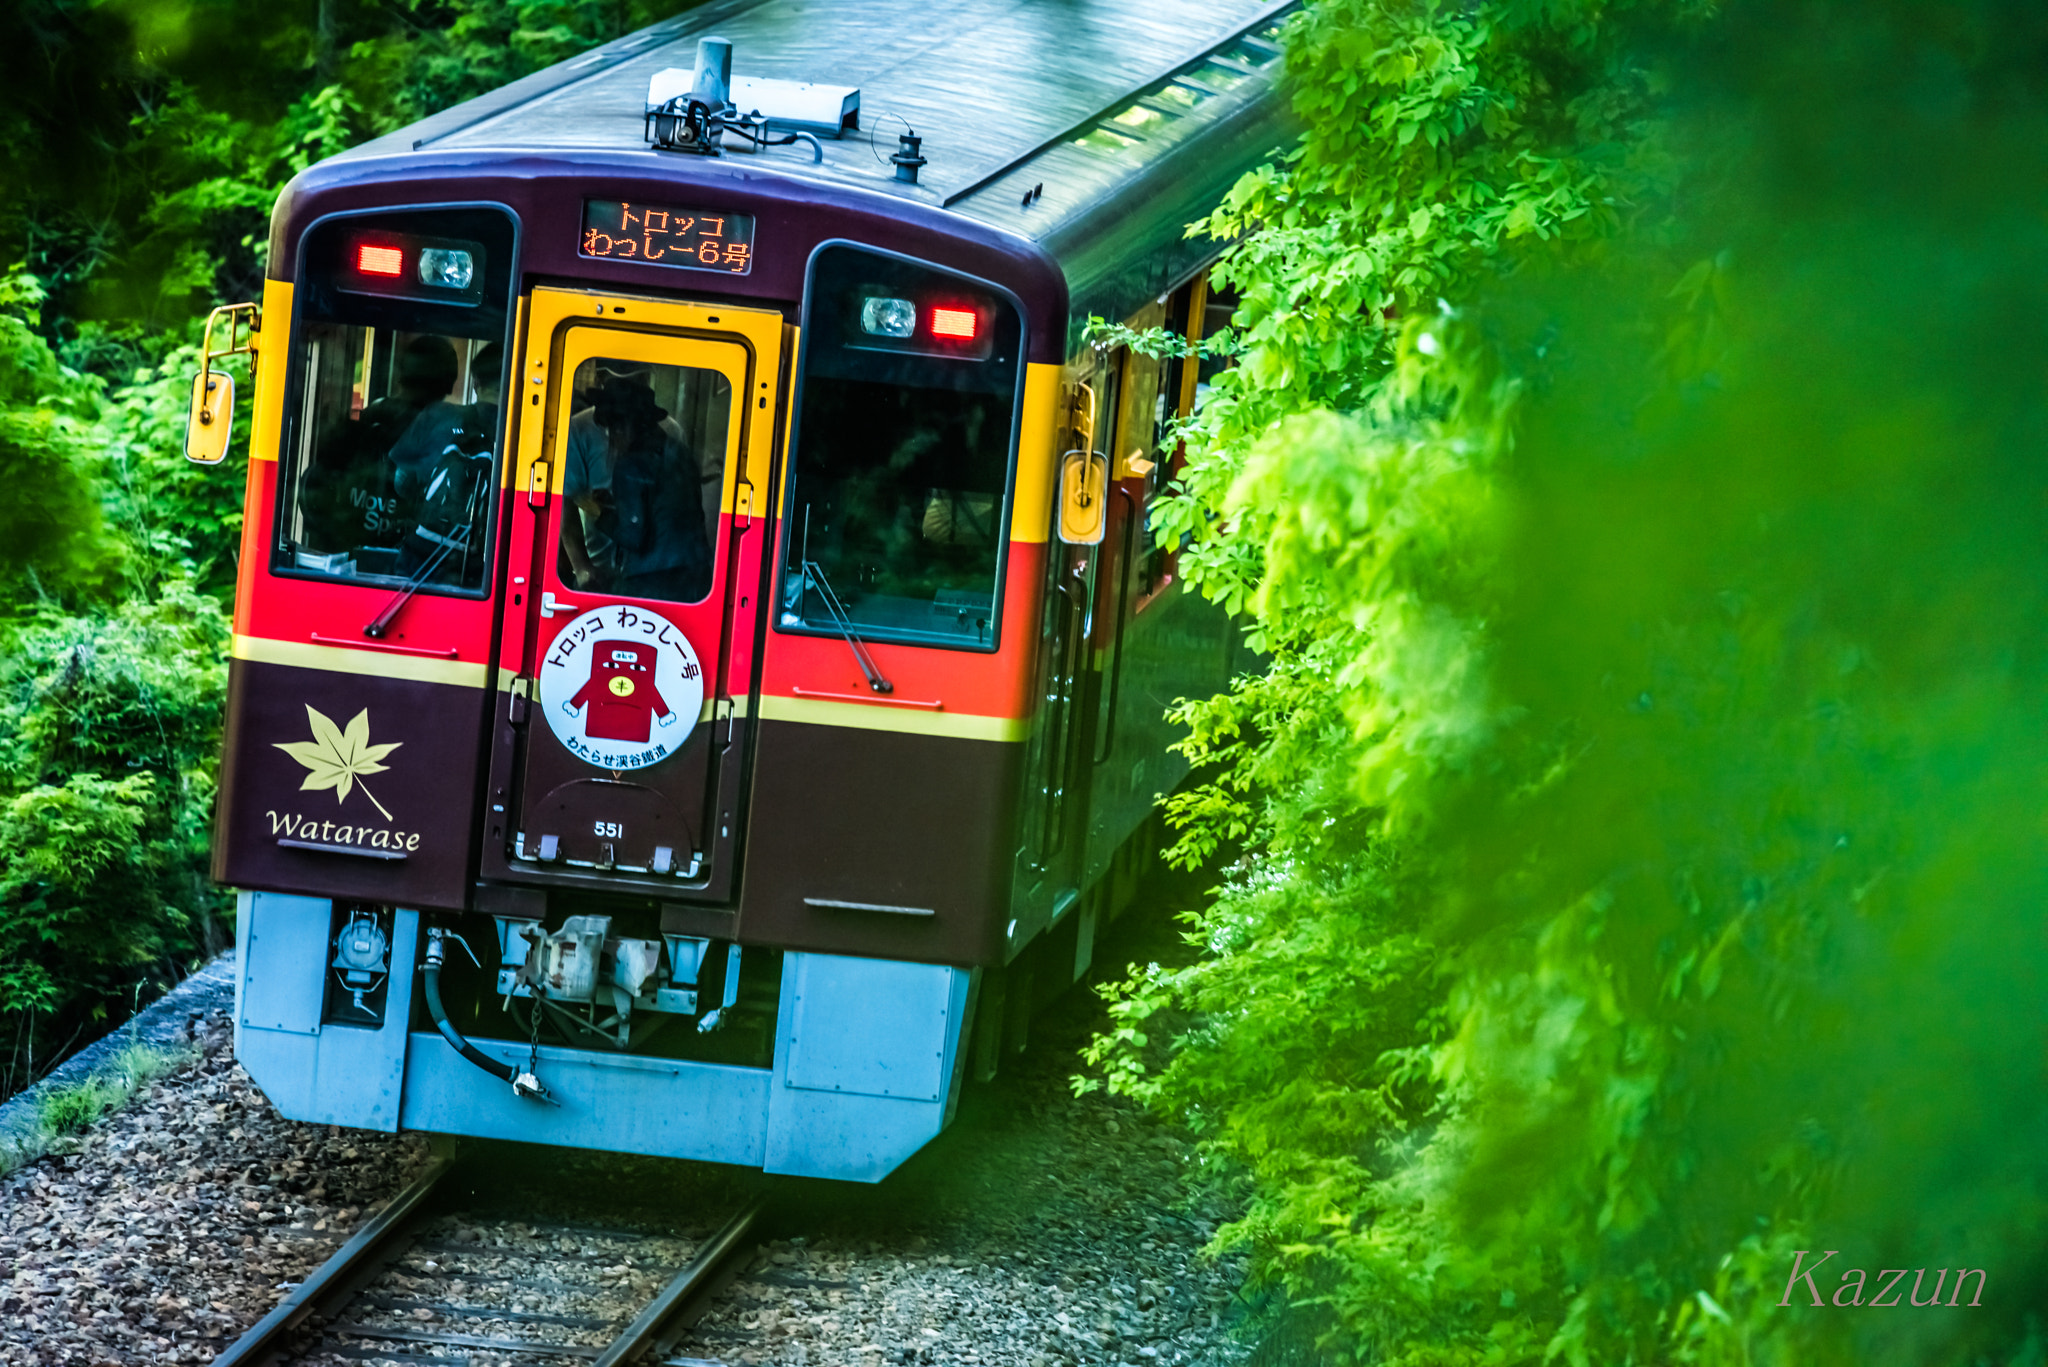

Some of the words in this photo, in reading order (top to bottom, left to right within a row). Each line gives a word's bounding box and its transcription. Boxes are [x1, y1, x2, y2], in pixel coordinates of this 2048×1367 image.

[621, 203, 724, 236] トロッコ
[583, 228, 750, 272] わっしー6号
[349, 487, 398, 514] Move
[548, 616, 604, 668] トロッコ
[617, 607, 700, 681] わっしー号
[266, 810, 420, 851] Watarase
[594, 821, 623, 839] 551
